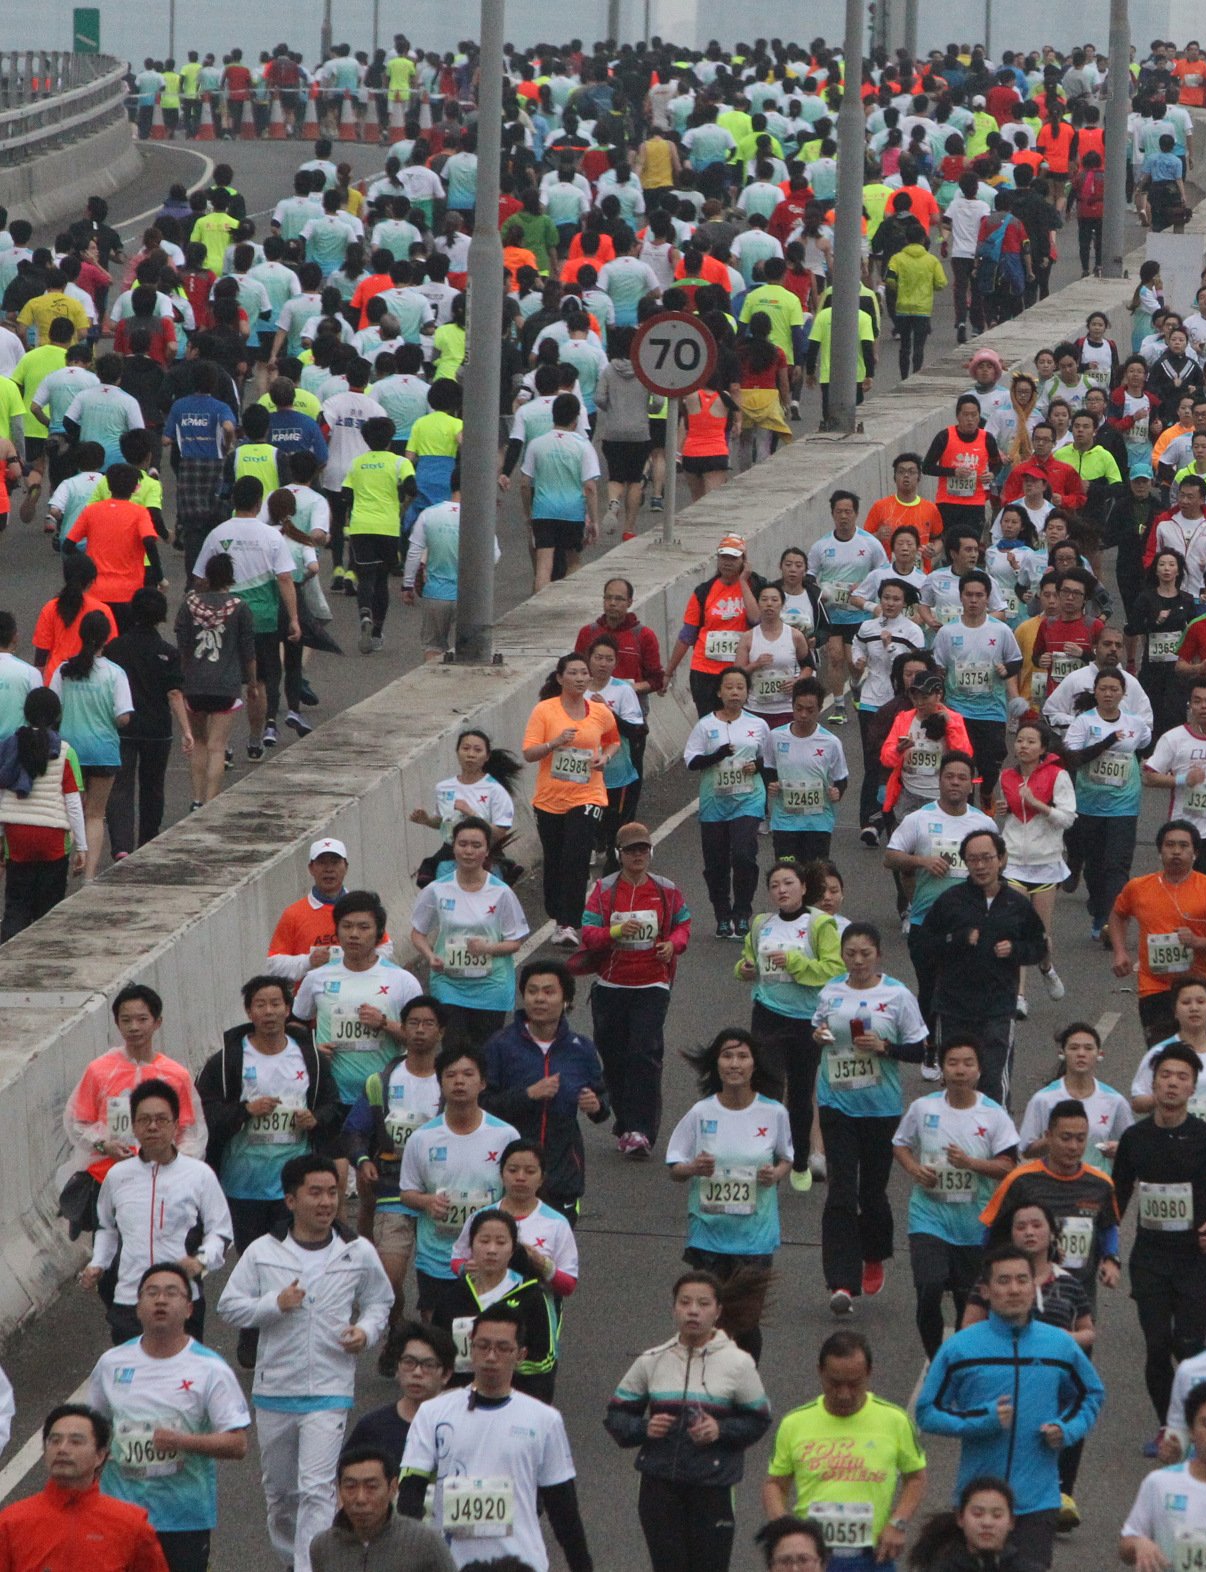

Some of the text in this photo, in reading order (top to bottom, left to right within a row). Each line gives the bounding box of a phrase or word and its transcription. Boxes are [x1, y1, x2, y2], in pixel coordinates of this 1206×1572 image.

[649, 337, 701, 371] 70
[181, 418, 208, 426] KPMG
[272, 433, 299, 441] KPMG
[959, 671, 989, 686] J3754
[760, 681, 783, 694] J289
[555, 757, 587, 775] J2984
[907, 752, 939, 767] J5959
[1094, 762, 1125, 778] J5601
[787, 791, 820, 805] J2458
[584, 806, 603, 820] YO
[1152, 947, 1188, 964] J5894
[833, 1059, 875, 1077] J5731
[253, 1113, 296, 1131] J5874
[706, 1183, 750, 1202] J2323
[1144, 1199, 1187, 1218] J0980
[450, 1499, 505, 1520] J4920
[825, 1522, 867, 1543] 0551
